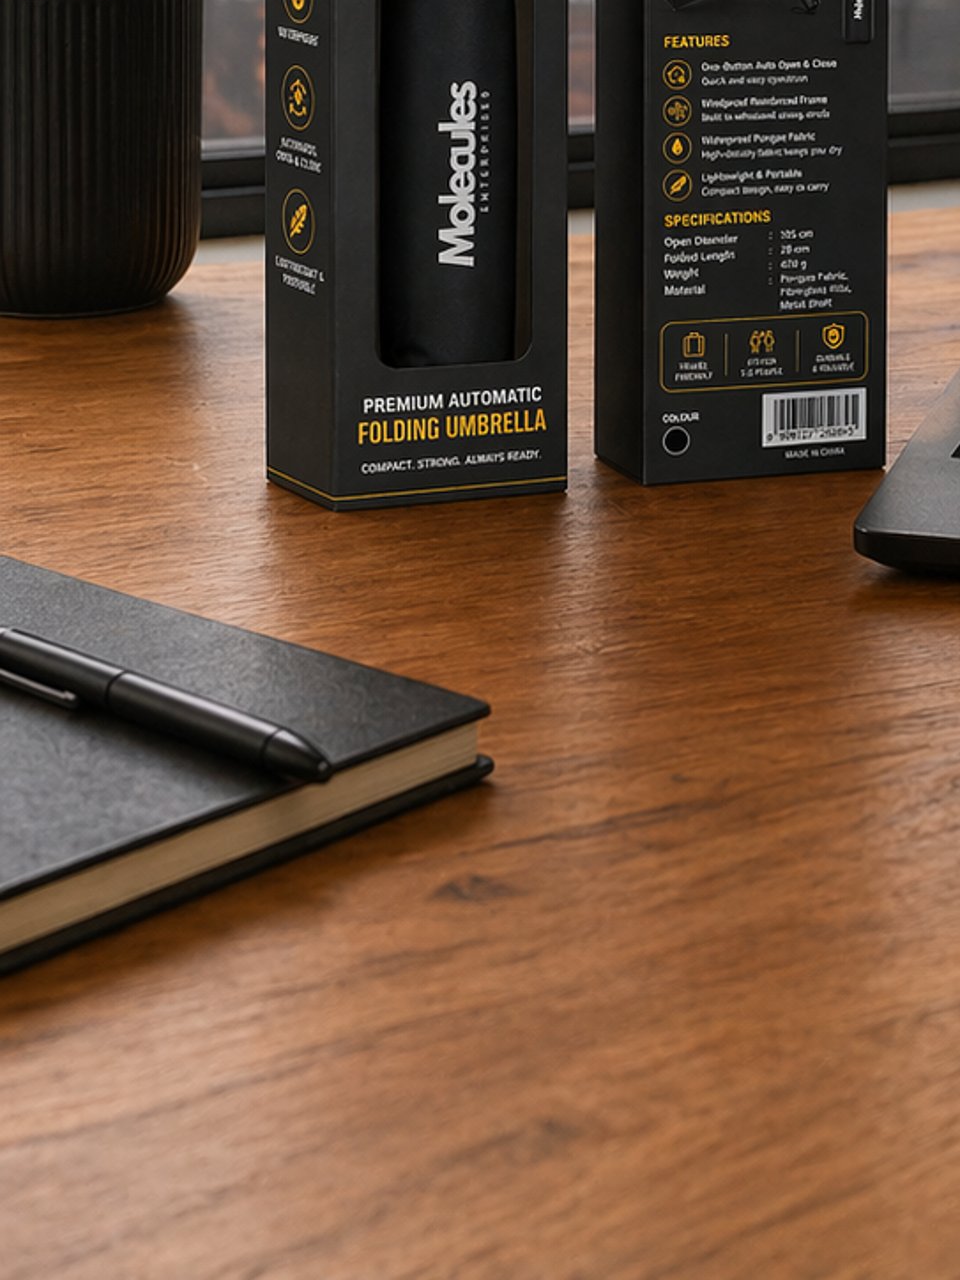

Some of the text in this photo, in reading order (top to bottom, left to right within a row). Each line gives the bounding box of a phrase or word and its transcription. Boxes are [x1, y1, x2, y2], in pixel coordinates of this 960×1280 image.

[664, 34, 730, 49] FEATURES
[438, 80, 477, 267] Molecules
[664, 210, 772, 227] SPECIFICATIONS
[363, 386, 542, 414] PREMIUM AUTOMATIC
[358, 408, 547, 445] FOLDING UMBRELLA
